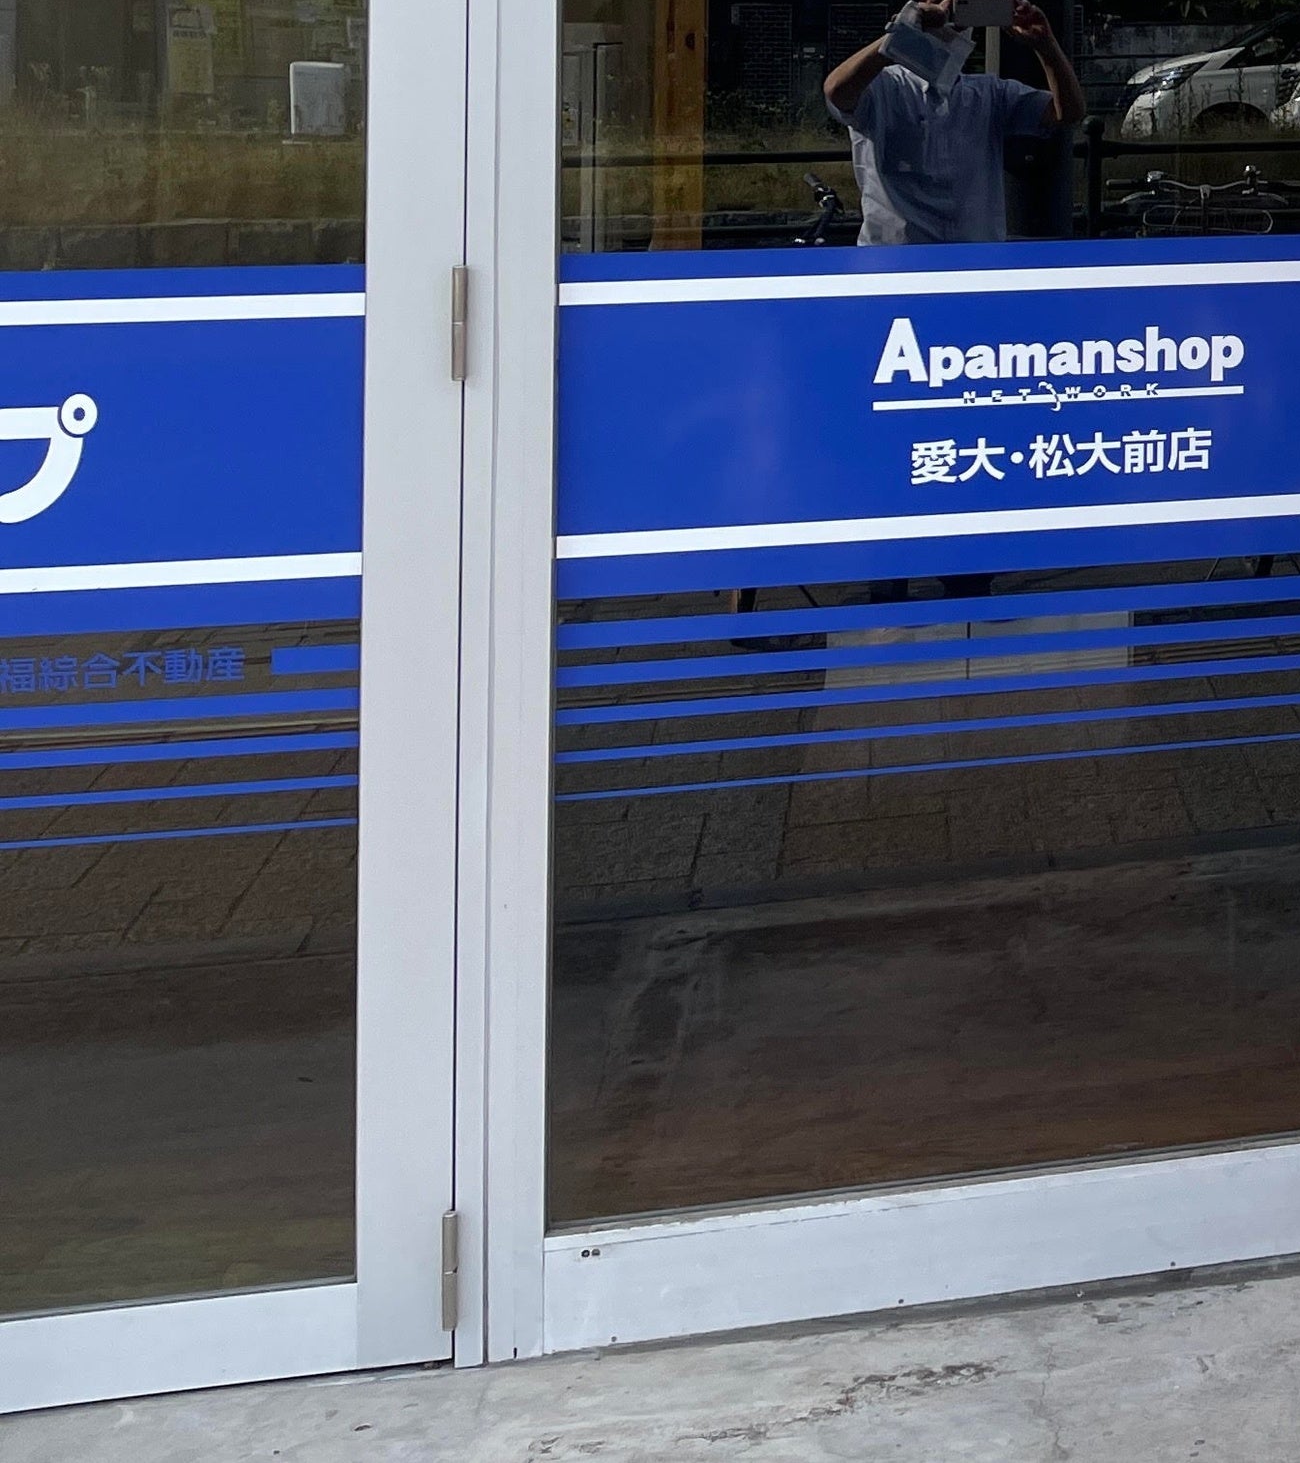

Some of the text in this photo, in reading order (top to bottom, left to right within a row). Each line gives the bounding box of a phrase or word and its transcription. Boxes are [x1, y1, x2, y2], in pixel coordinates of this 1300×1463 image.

[873, 317, 1244, 388] Apamanshop
[910, 427, 1213, 486] 愛大・松大前店
